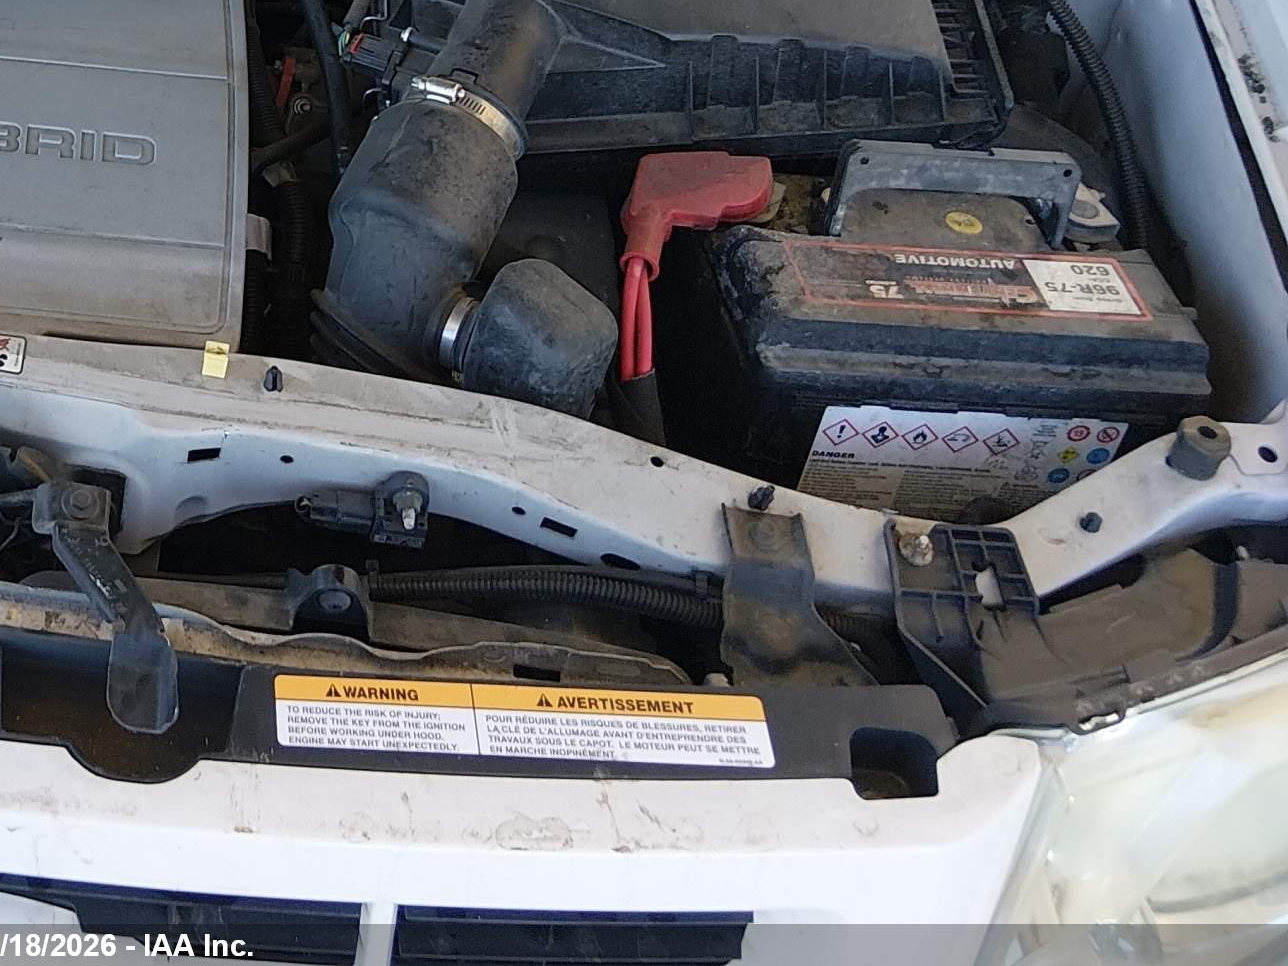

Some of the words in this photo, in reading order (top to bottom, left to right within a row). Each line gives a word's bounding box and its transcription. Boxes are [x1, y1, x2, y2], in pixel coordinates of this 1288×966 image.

[895, 253, 1016, 270] AUTOMOTIVE
[1069, 265, 1110, 277] 620
[1044, 281, 1121, 296] 96R-75
[811, 450, 855, 459] DANGER
[343, 685, 419, 701] WARNING
[287, 705, 299, 714] TO
[303, 706, 341, 715] REDUCE
[345, 708, 362, 716] THE
[365, 709, 386, 717] RISK
[389, 710, 402, 718] OF
[557, 696, 694, 714] AVERTISSEMENT
[288, 716, 327, 725] REMOVE
[330, 718, 349, 726] THE
[351, 719, 370, 727] KEY
[373, 720, 400, 728] FROM
[402, 721, 421, 729] THE
[424, 722, 465, 731] IGNITION
[486, 714, 512, 723] POUR
[515, 715, 558, 725] RÉDUIRE
[560, 718, 578, 726] LES
[580, 719, 624, 728] RISQUES
[704, 725, 746, 734] RETIRER
[288, 726, 327, 735] BEFORE
[330, 728, 375, 737] WORKING
[378, 730, 411, 739] UNDER
[502, 724, 521, 733] CLÉ
[523, 726, 537, 734] DE
[539, 727, 600, 738] L'ALLUMAGE
[603, 730, 633, 740] AVANT
[726, 736, 746, 744] DES
[289, 736, 325, 744] ENGINE
[328, 738, 347, 746] MAY
[350, 739, 380, 748] START
[488, 735, 532, 744] TRAVAUX
[535, 737, 562, 746] SOUS
[564, 738, 577, 746] LE
[619, 741, 631, 749] LE
[634, 742, 675, 751] MOTEUR
[678, 744, 703, 752] PEUT
[705, 745, 719, 753] SE
[721, 746, 760, 755] METTRE
[490, 745, 503, 753] EN
[506, 746, 547, 755] MARCHE
